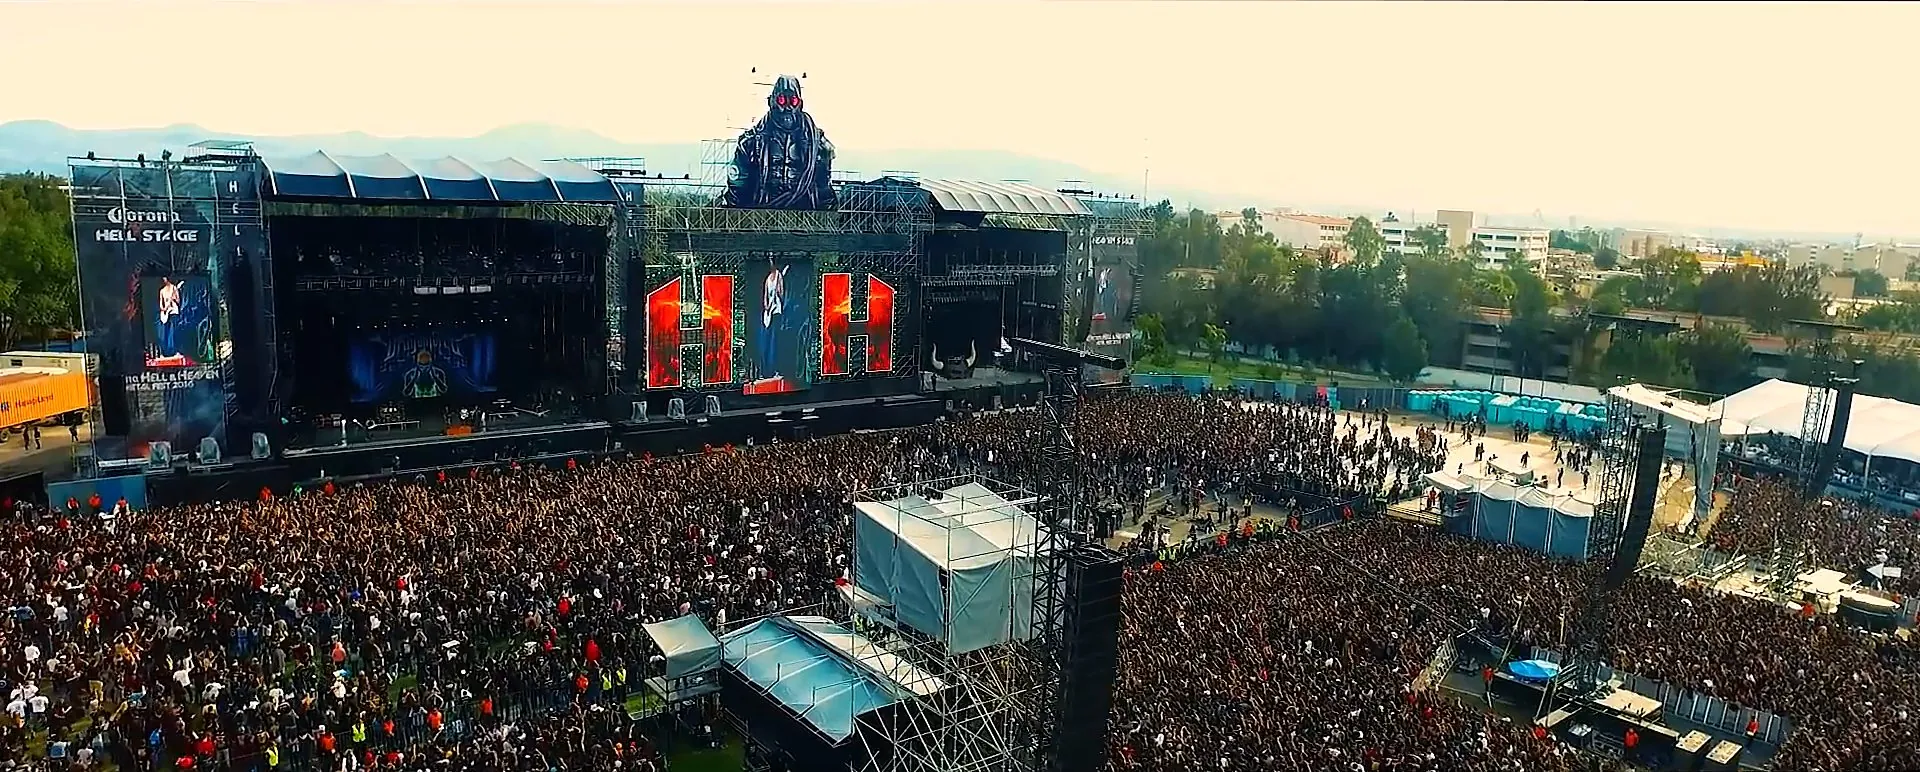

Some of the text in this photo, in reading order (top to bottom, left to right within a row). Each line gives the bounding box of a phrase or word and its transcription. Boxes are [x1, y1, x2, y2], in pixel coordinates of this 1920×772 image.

[108, 206, 181, 223] Corona
[95, 229, 199, 242] HELL STAGE
[647, 272, 896, 389] H H
[140, 372, 168, 383] HELL
